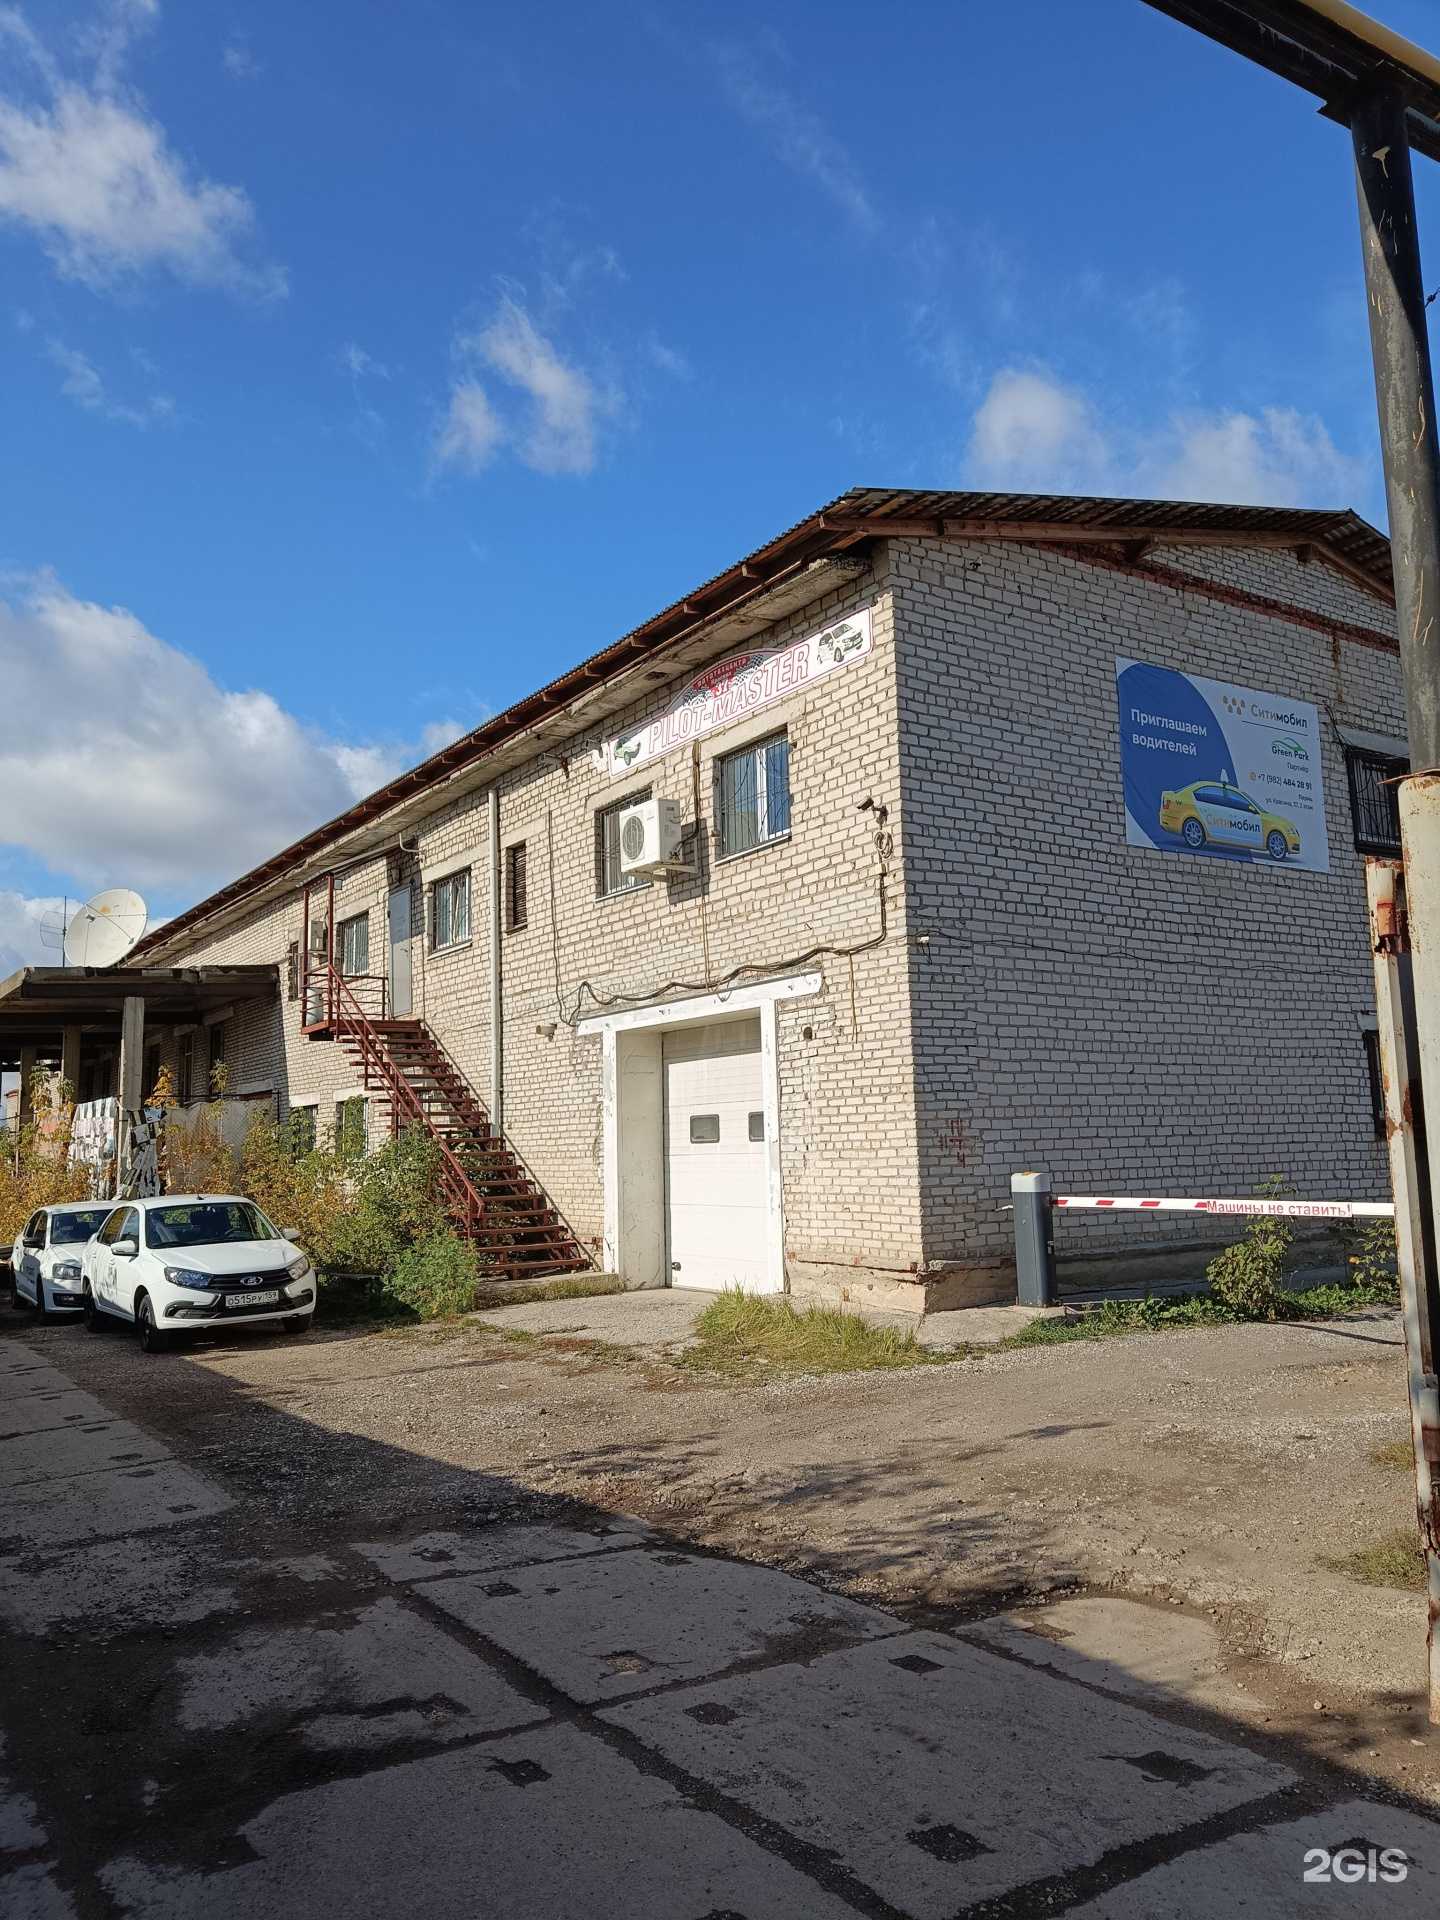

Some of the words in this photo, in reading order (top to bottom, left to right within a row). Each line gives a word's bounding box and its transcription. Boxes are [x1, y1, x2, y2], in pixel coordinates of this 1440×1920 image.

[650, 644, 810, 752] PILOT-MASTER
[1131, 708, 1207, 736] Приглашаем
[1251, 704, 1308, 728] Ситимобил
[1132, 733, 1197, 756] водителей
[1271, 745, 1293, 758] Green
[1294, 750, 1310, 761] Park
[1207, 1200, 1263, 1213] Машины
[1268, 1203, 1284, 1214] не
[1288, 1204, 1351, 1216] ставить!
